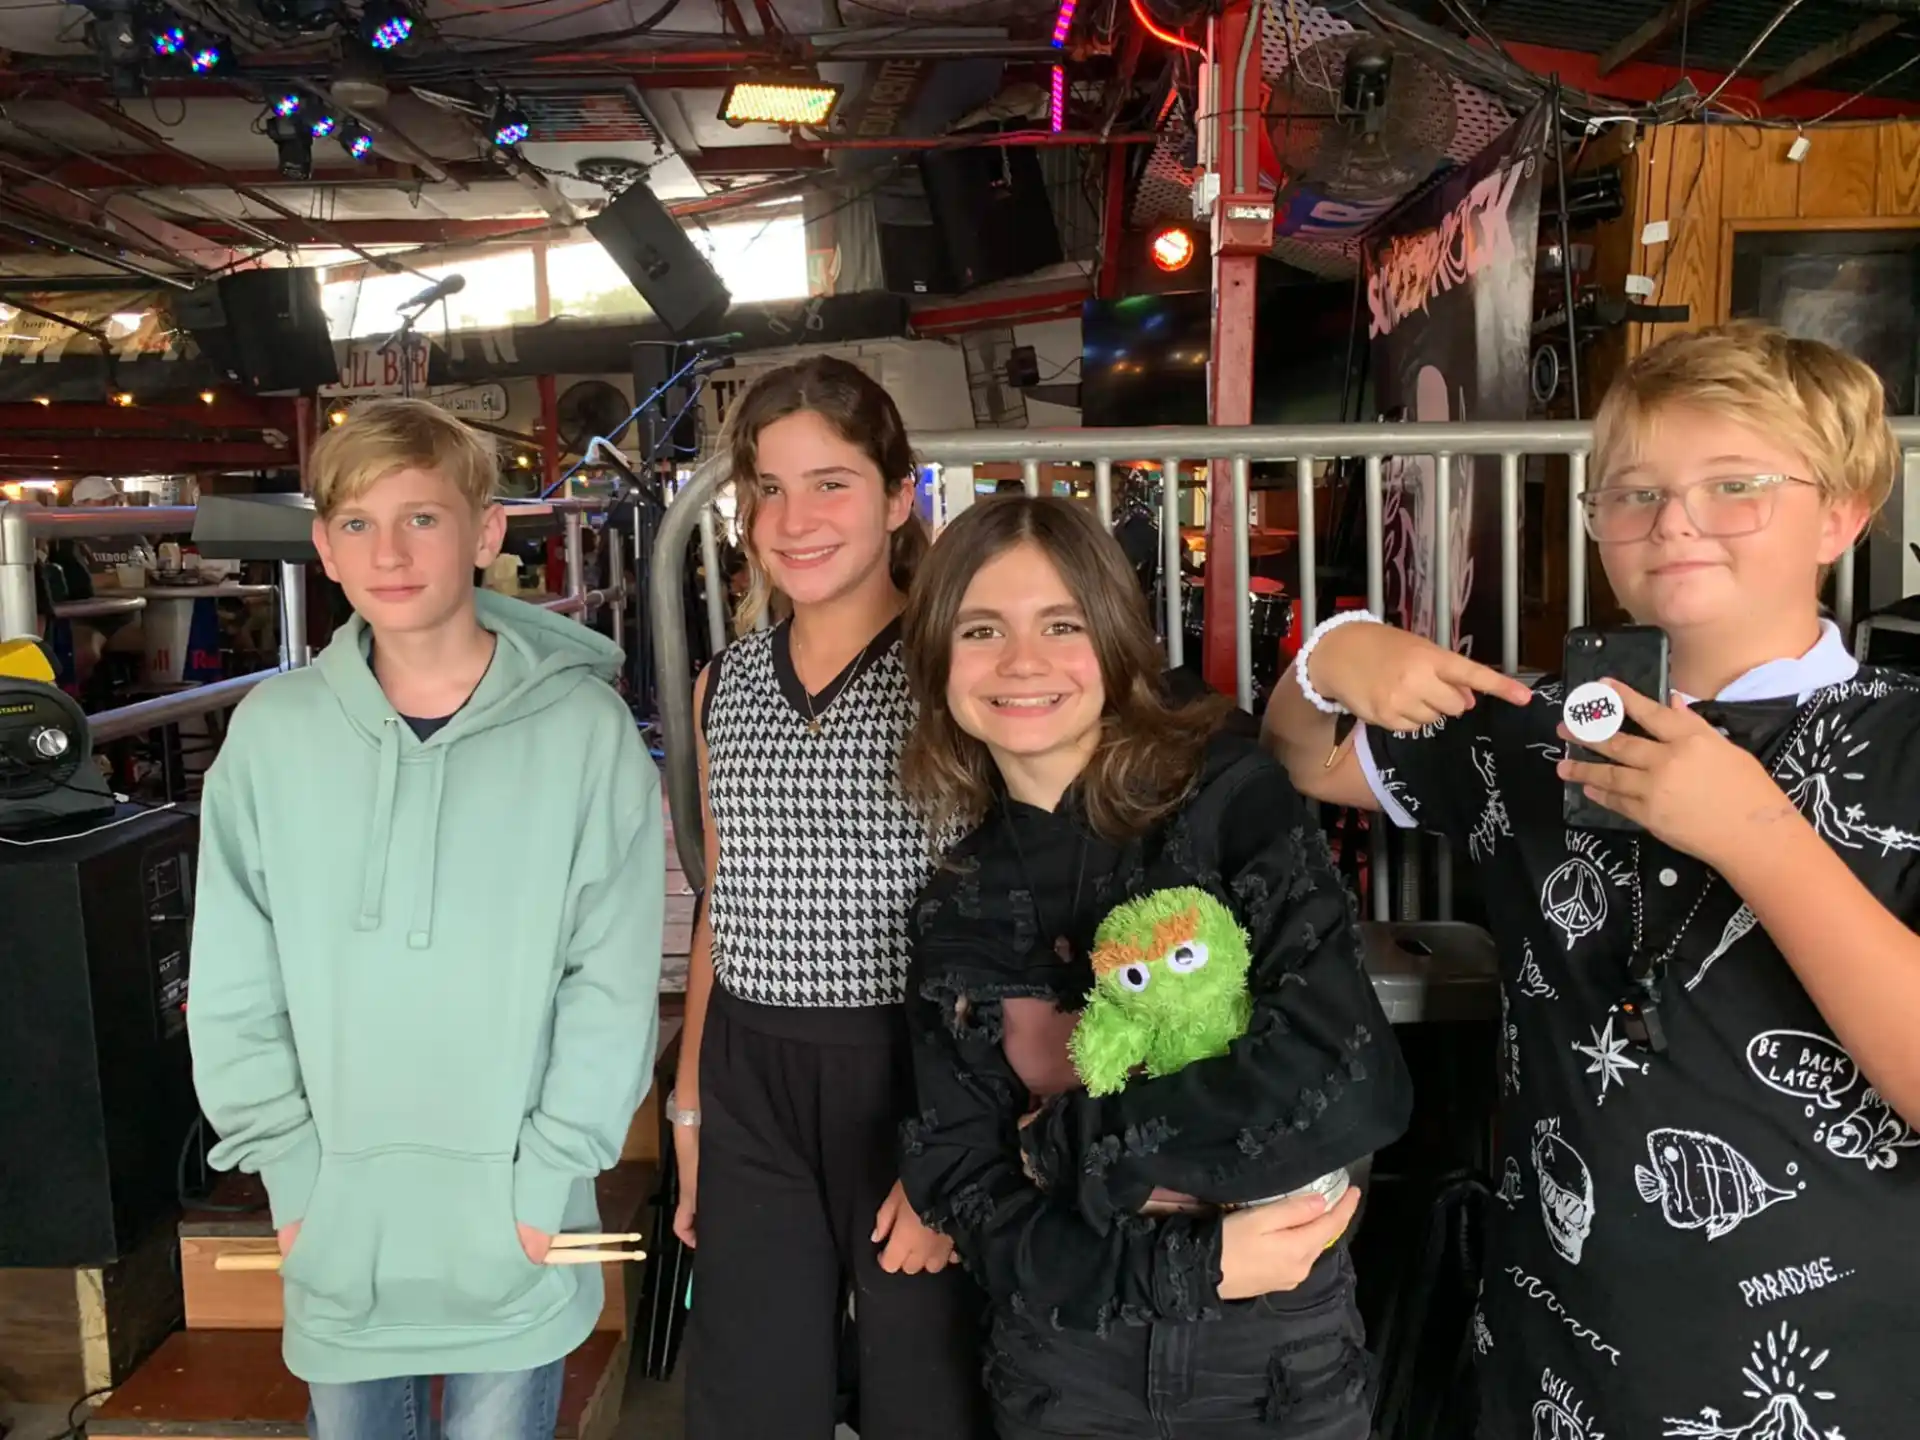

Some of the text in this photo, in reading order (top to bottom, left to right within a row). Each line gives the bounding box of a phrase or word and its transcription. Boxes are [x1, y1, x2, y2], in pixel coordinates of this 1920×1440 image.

[326, 350, 377, 390] ULL
[1757, 1037, 1848, 1075] BE BACK
[1768, 1065, 1833, 1092] LATER
